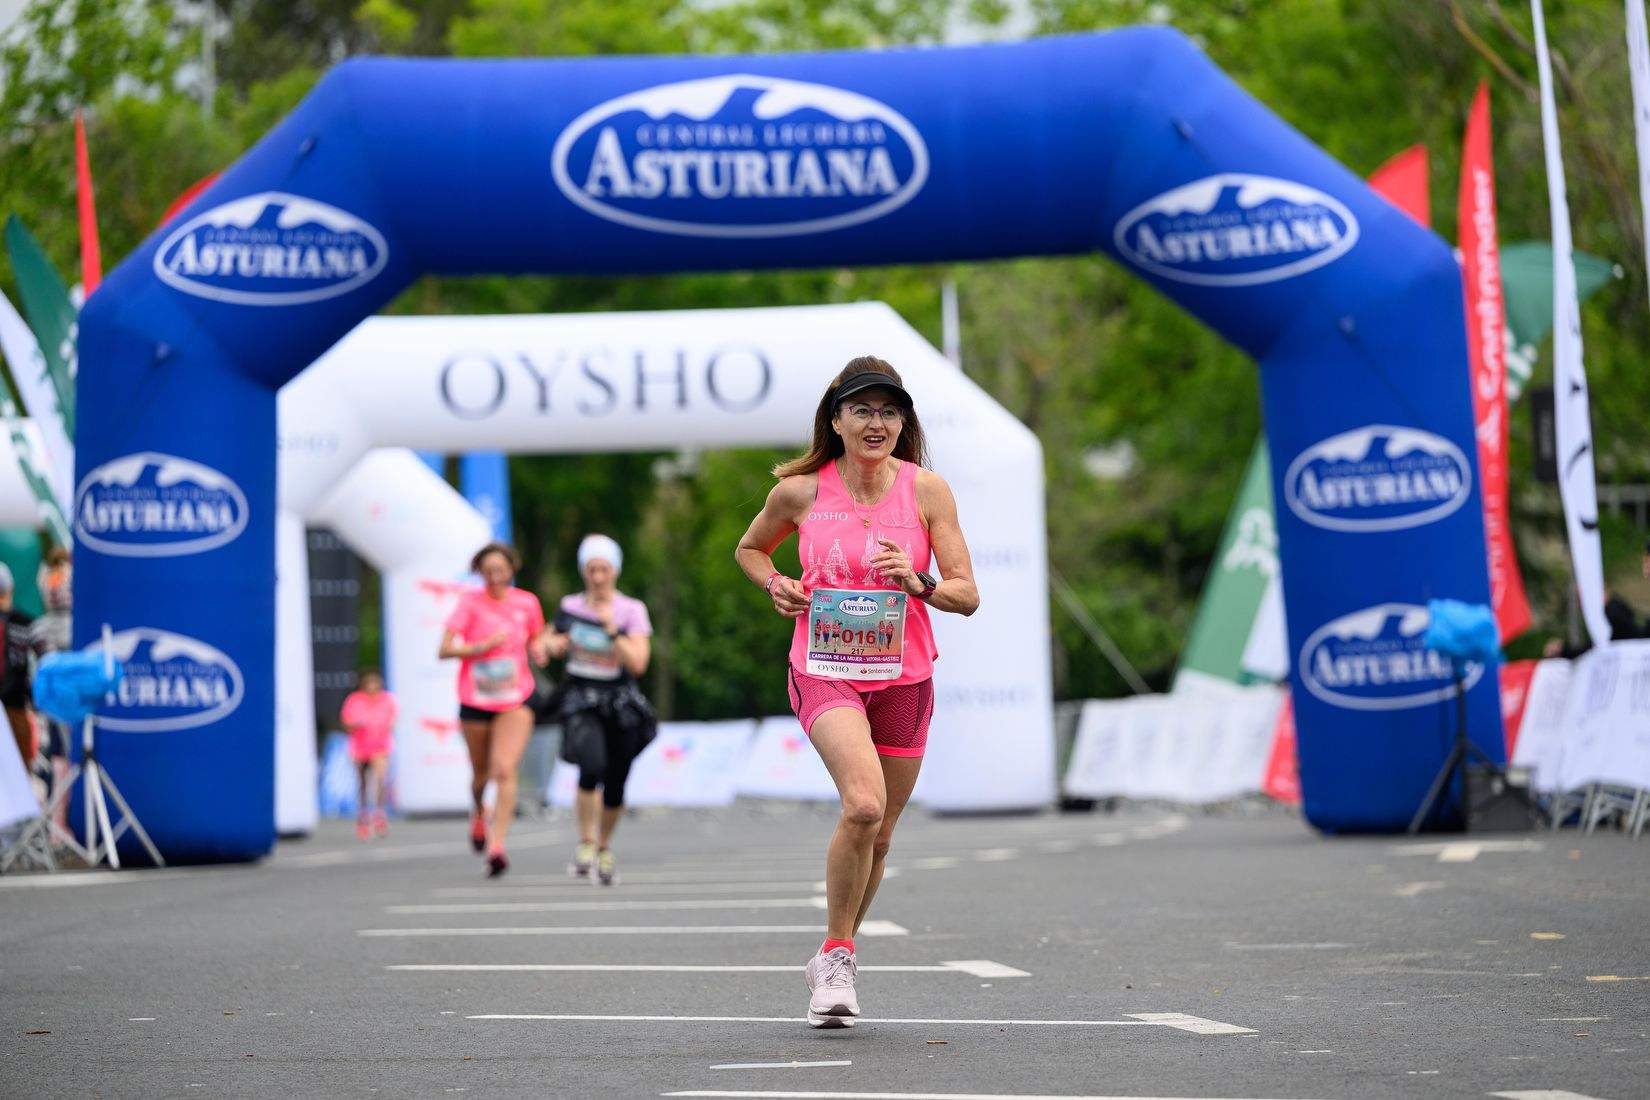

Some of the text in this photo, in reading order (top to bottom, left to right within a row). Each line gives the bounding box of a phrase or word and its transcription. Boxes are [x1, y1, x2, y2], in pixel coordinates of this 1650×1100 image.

[635, 121, 887, 146] CENTRAL LECHERA
[583, 126, 900, 199] ASTURIANA
[168, 231, 370, 279] ASTURIANA
[1136, 217, 1342, 264] ASTURIANA
[439, 346, 773, 421] OYSHO
[1299, 466, 1461, 510] ASTURIANA
[82, 491, 235, 533] ASTURIANA
[808, 511, 849, 521] OYSHO
[841, 602, 877, 612] ASTURIANA
[841, 629, 876, 645] 016
[818, 664, 849, 673] OYSHO
[1312, 644, 1454, 688] ASTURIA
[104, 675, 230, 708] URIANA
